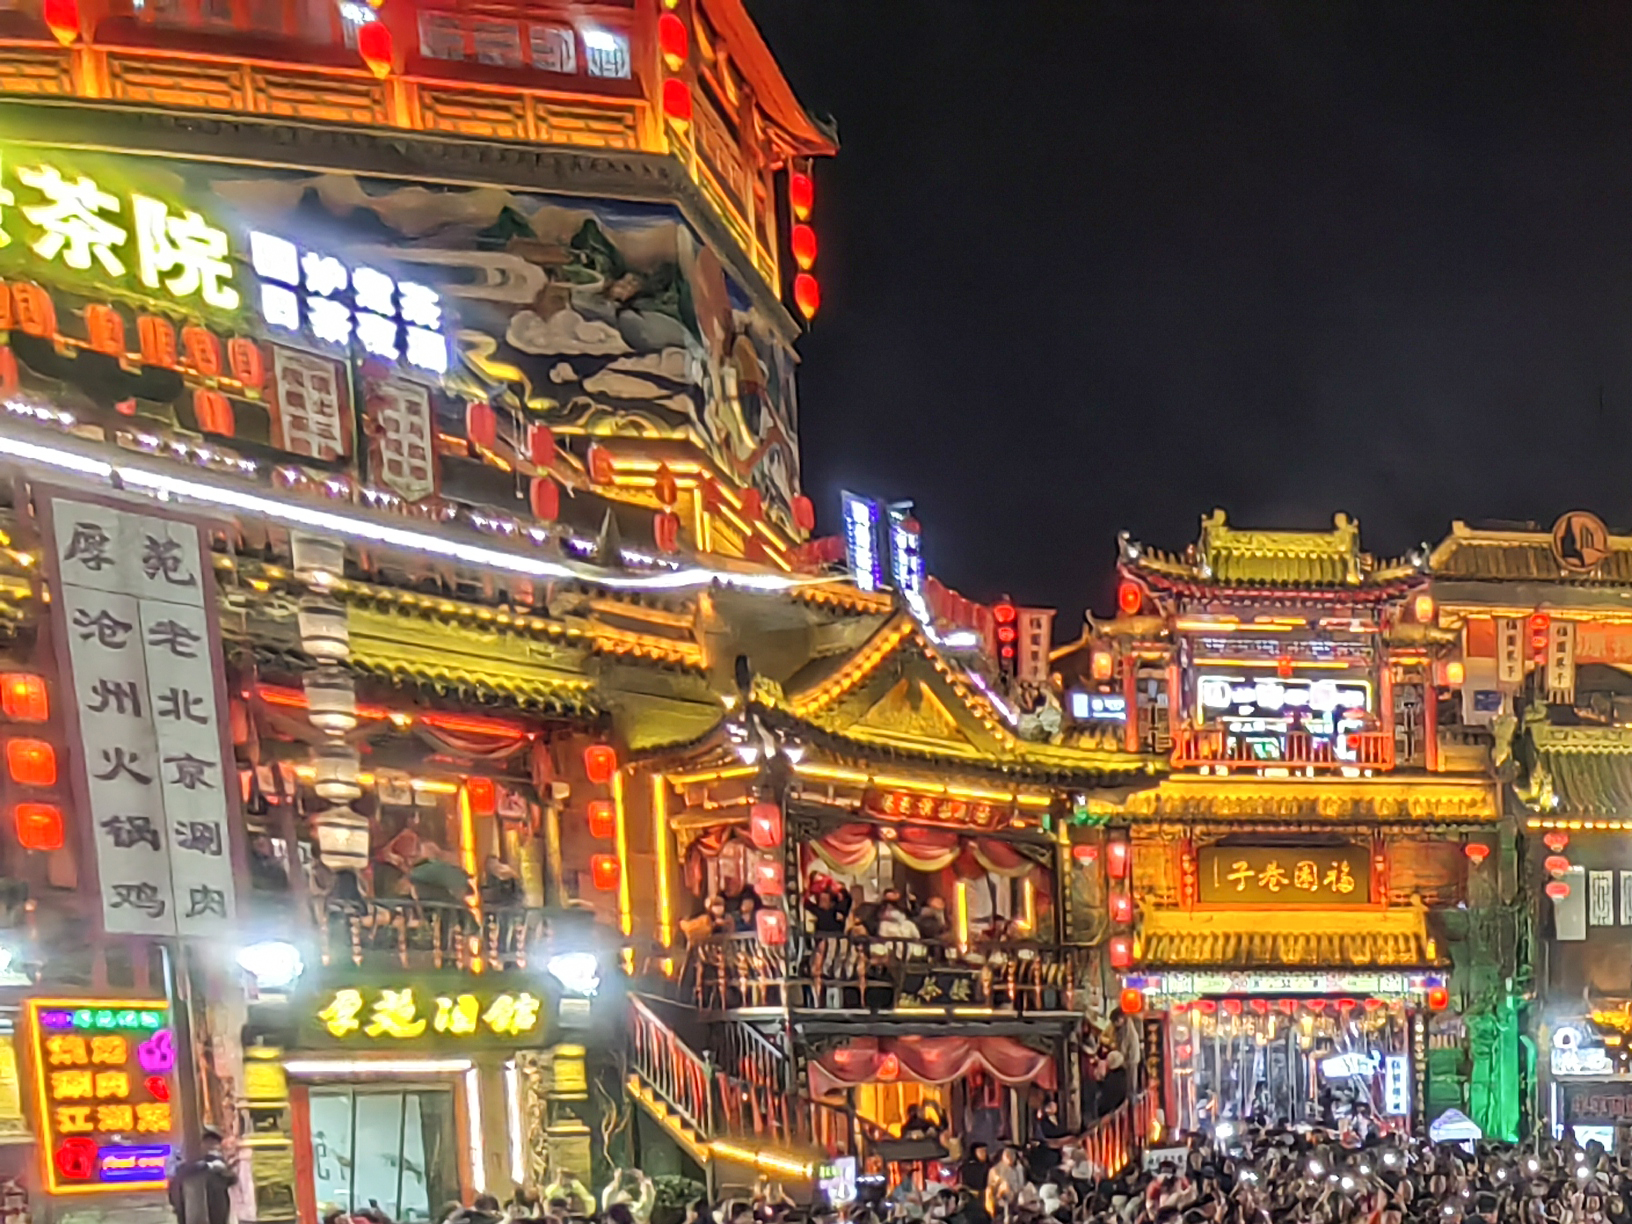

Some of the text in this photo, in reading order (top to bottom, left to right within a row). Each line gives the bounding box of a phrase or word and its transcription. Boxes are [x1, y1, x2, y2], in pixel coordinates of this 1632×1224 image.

[0, 164, 239, 310] 茶院
[64, 522, 197, 586] 厚苑
[73, 608, 165, 918] 沧州火锅鸡
[148, 619, 226, 918] 老北京涮肉
